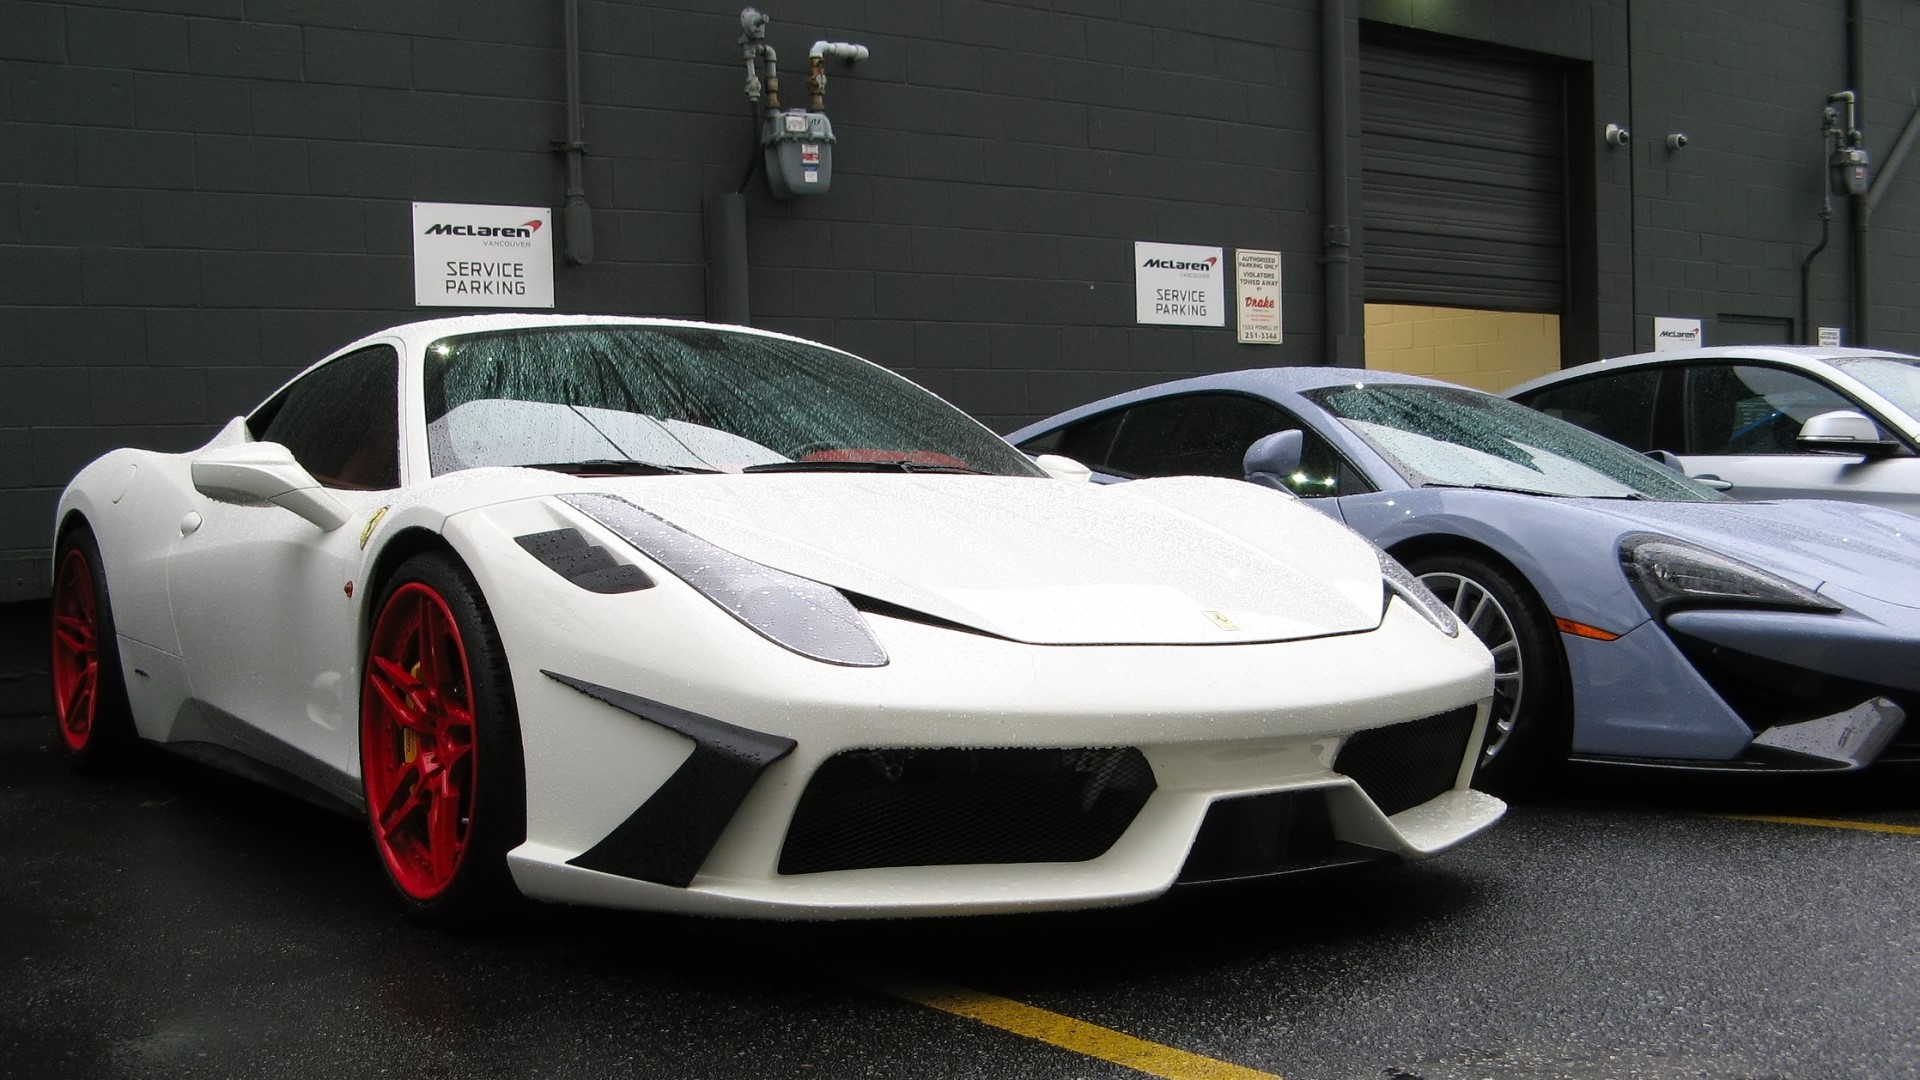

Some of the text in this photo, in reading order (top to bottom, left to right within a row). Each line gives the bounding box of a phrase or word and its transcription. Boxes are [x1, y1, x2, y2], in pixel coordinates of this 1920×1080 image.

[424, 223, 531, 238] McLaren
[483, 240, 531, 248] VANCOUVER
[1142, 258, 1210, 271] McLaren
[1241, 256, 1276, 264] AUTHORIZED
[446, 261, 524, 278] SERVICE
[1243, 271, 1275, 279] VIOLATORS
[445, 280, 526, 295] PARKING
[1156, 289, 1206, 303] SERVICE
[1244, 296, 1275, 309] Drake
[1155, 303, 1207, 317] PARKING
[1244, 332, 1277, 340] 251-3344
[1659, 330, 1696, 339] McLaren
